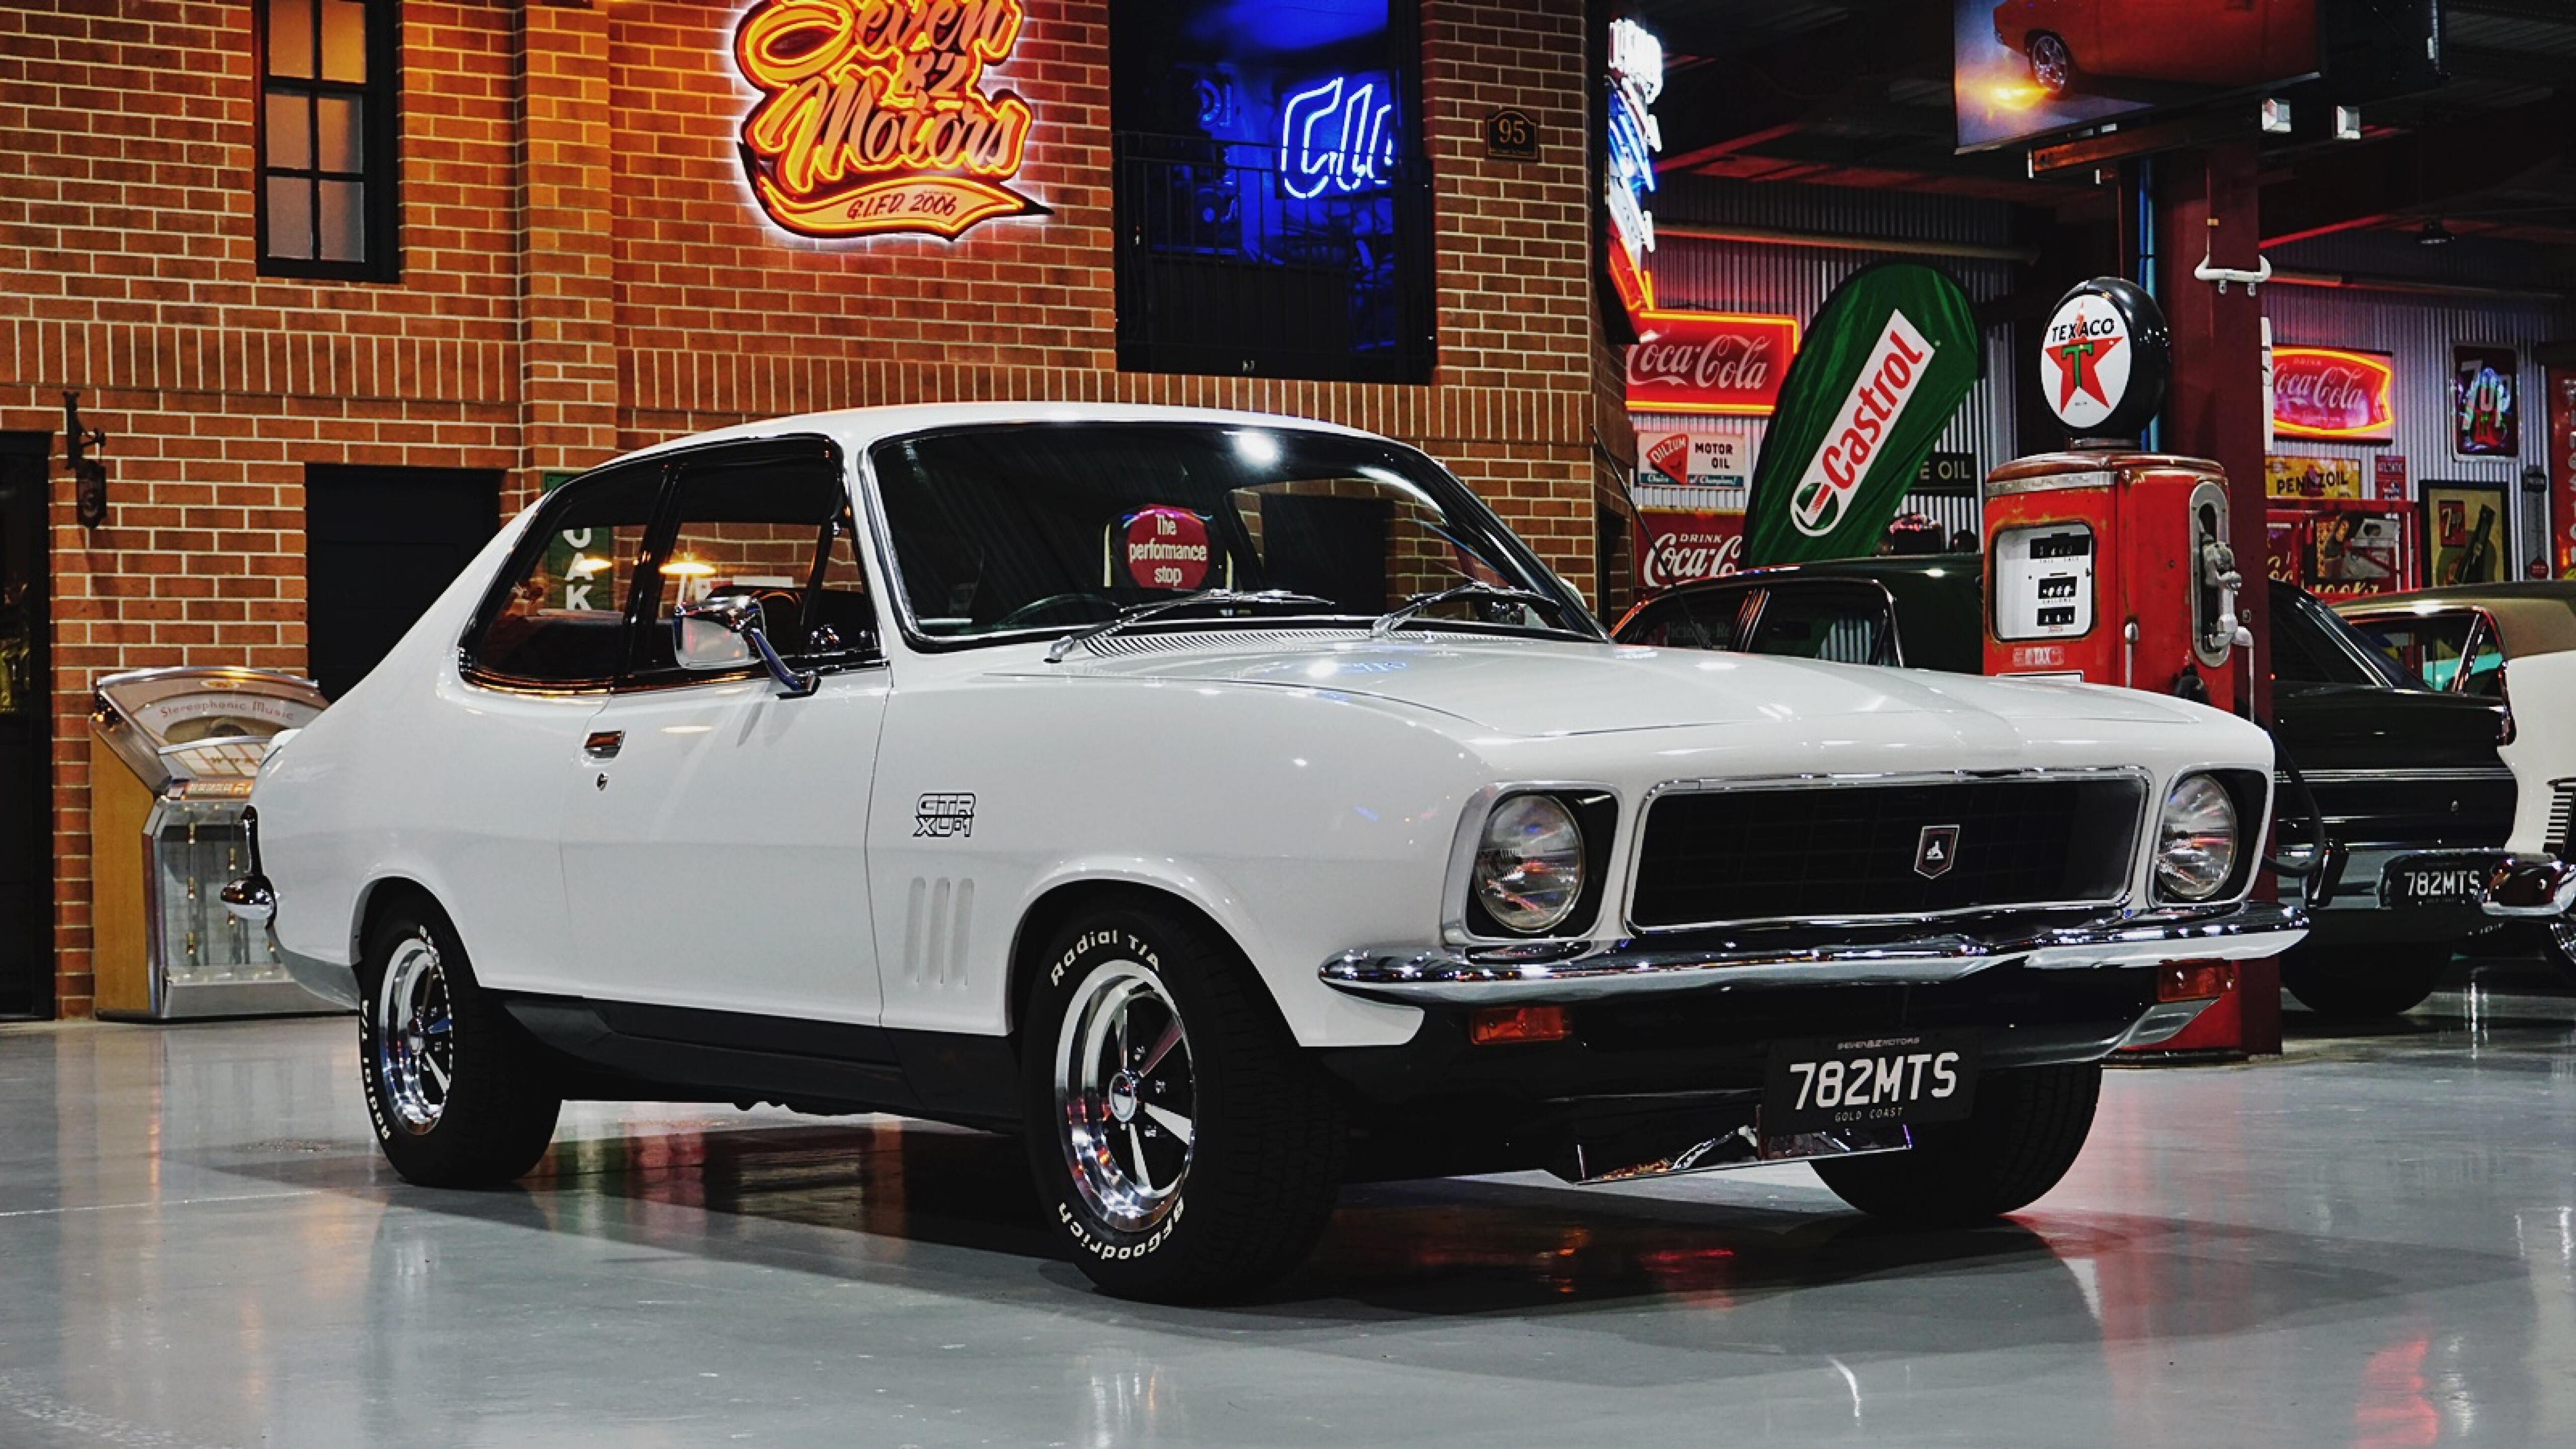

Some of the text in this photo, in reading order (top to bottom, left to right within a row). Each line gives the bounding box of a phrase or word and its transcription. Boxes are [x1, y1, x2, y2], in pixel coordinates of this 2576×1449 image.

[904, 51, 968, 97] 82
[755, 76, 1022, 192] Motors
[1499, 119, 1525, 144] 95
[908, 192, 957, 217] 2006
[2052, 317, 2115, 343] TEXACO
[1821, 329, 1925, 491] Castrol
[1650, 437, 1686, 464] OILZUM
[1695, 442, 1733, 455] MOTOR
[1711, 457, 1731, 469] OIL
[1937, 460, 1971, 480] OIL
[1155, 513, 1177, 536] The
[1129, 538, 1208, 564] performance
[1679, 533, 1723, 544] DRINK
[1154, 566, 1183, 587] stop
[159, 699, 294, 720] Stereophonic Music
[915, 792, 976, 817] GTR
[2403, 870, 2480, 897] 782MTS
[1051, 928, 1118, 988] Radial
[1789, 1051, 1960, 1110] 782MTS
[1834, 1107, 1904, 1122] GOLD COAST
[1057, 1196, 1185, 1260] BFGoodrich
